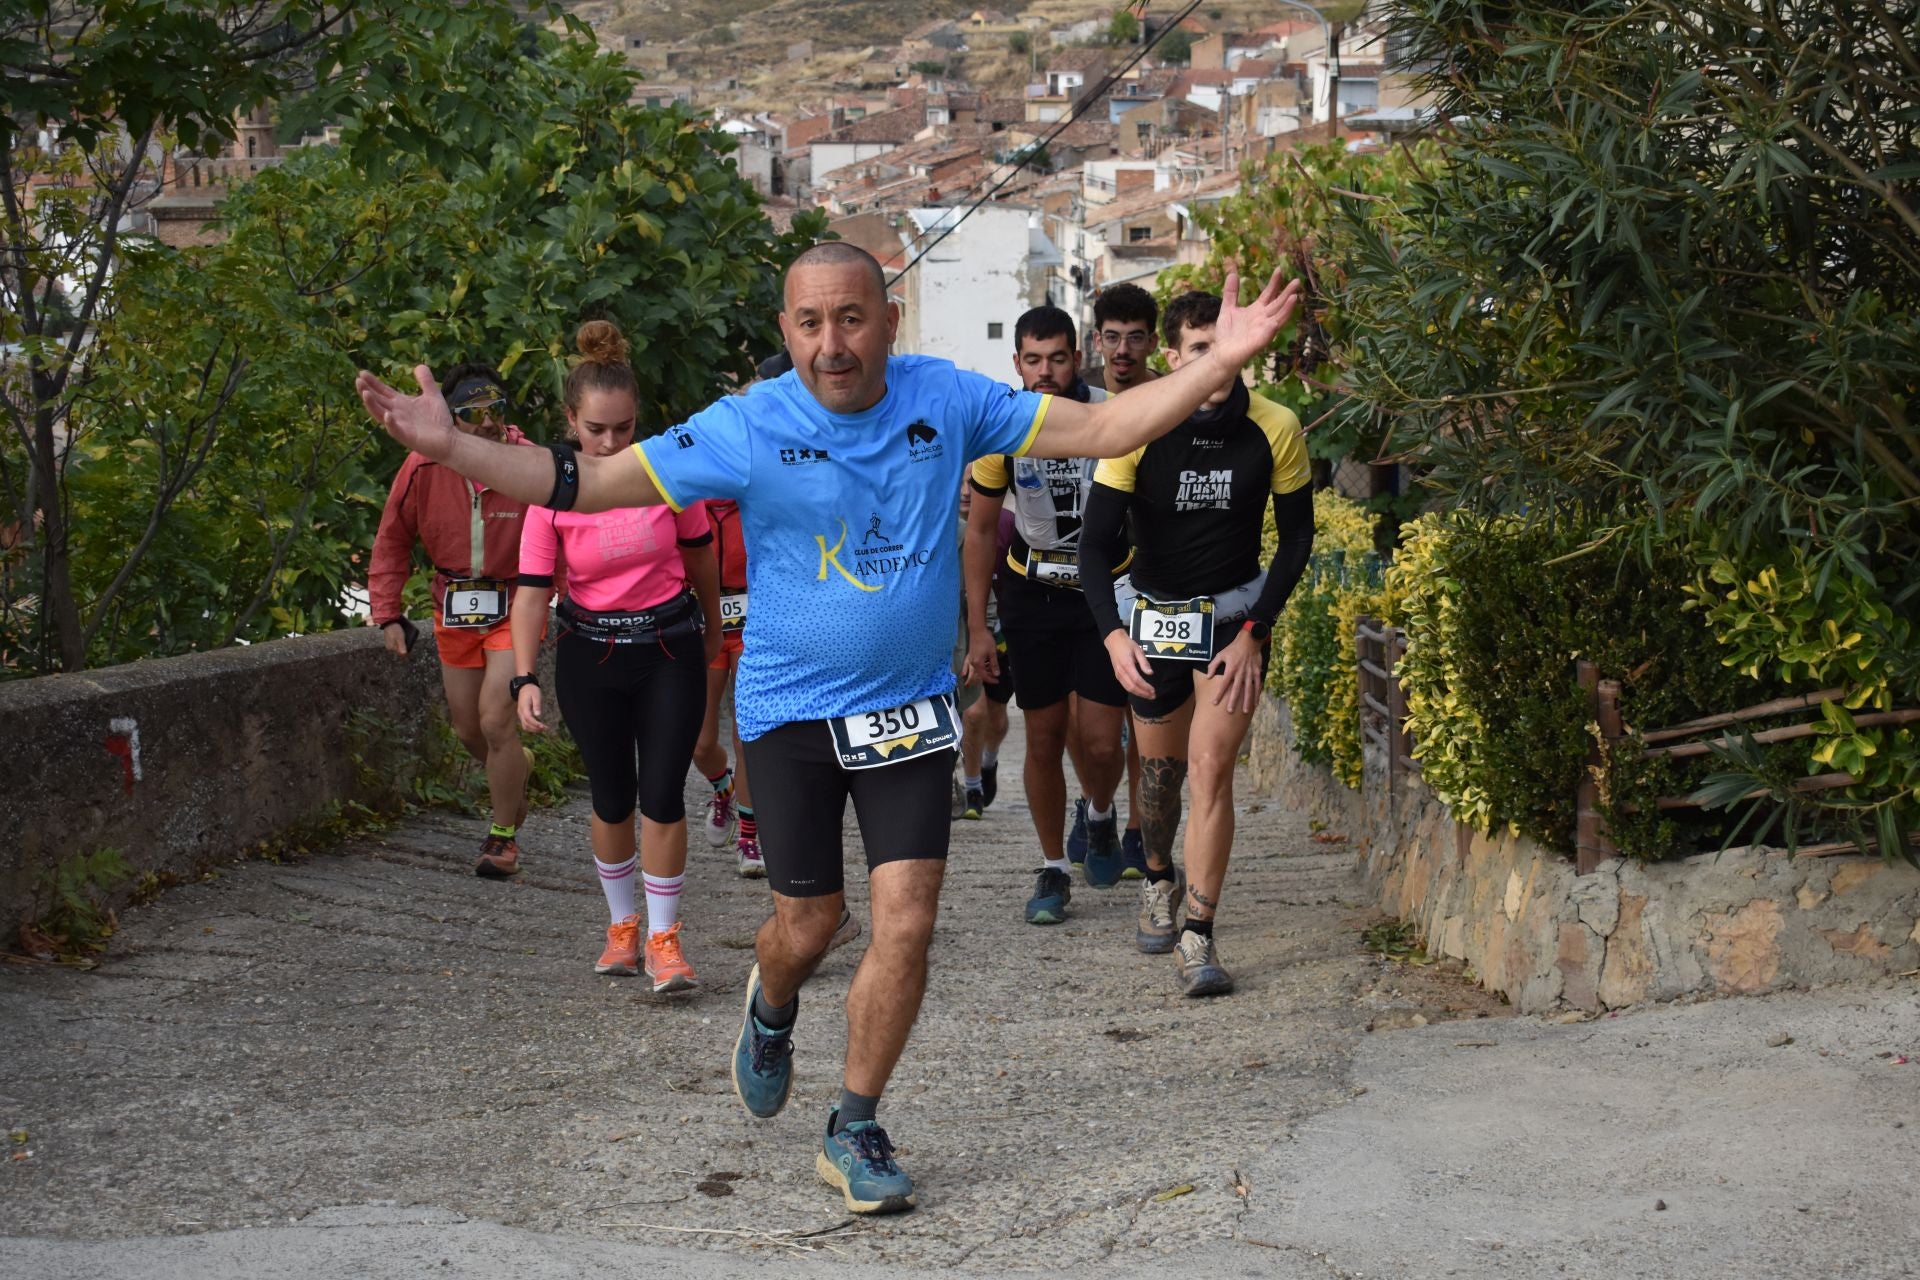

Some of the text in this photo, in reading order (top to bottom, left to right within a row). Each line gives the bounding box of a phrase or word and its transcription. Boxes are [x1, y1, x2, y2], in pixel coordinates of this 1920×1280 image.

[1179, 469, 1233, 483] CxM
[854, 548, 869, 556] CLUB
[879, 544, 904, 553] CORRER
[470, 597, 479, 611] 9
[1153, 620, 1191, 639] 298
[865, 704, 920, 738] 350
[926, 733, 953, 745] b.power
